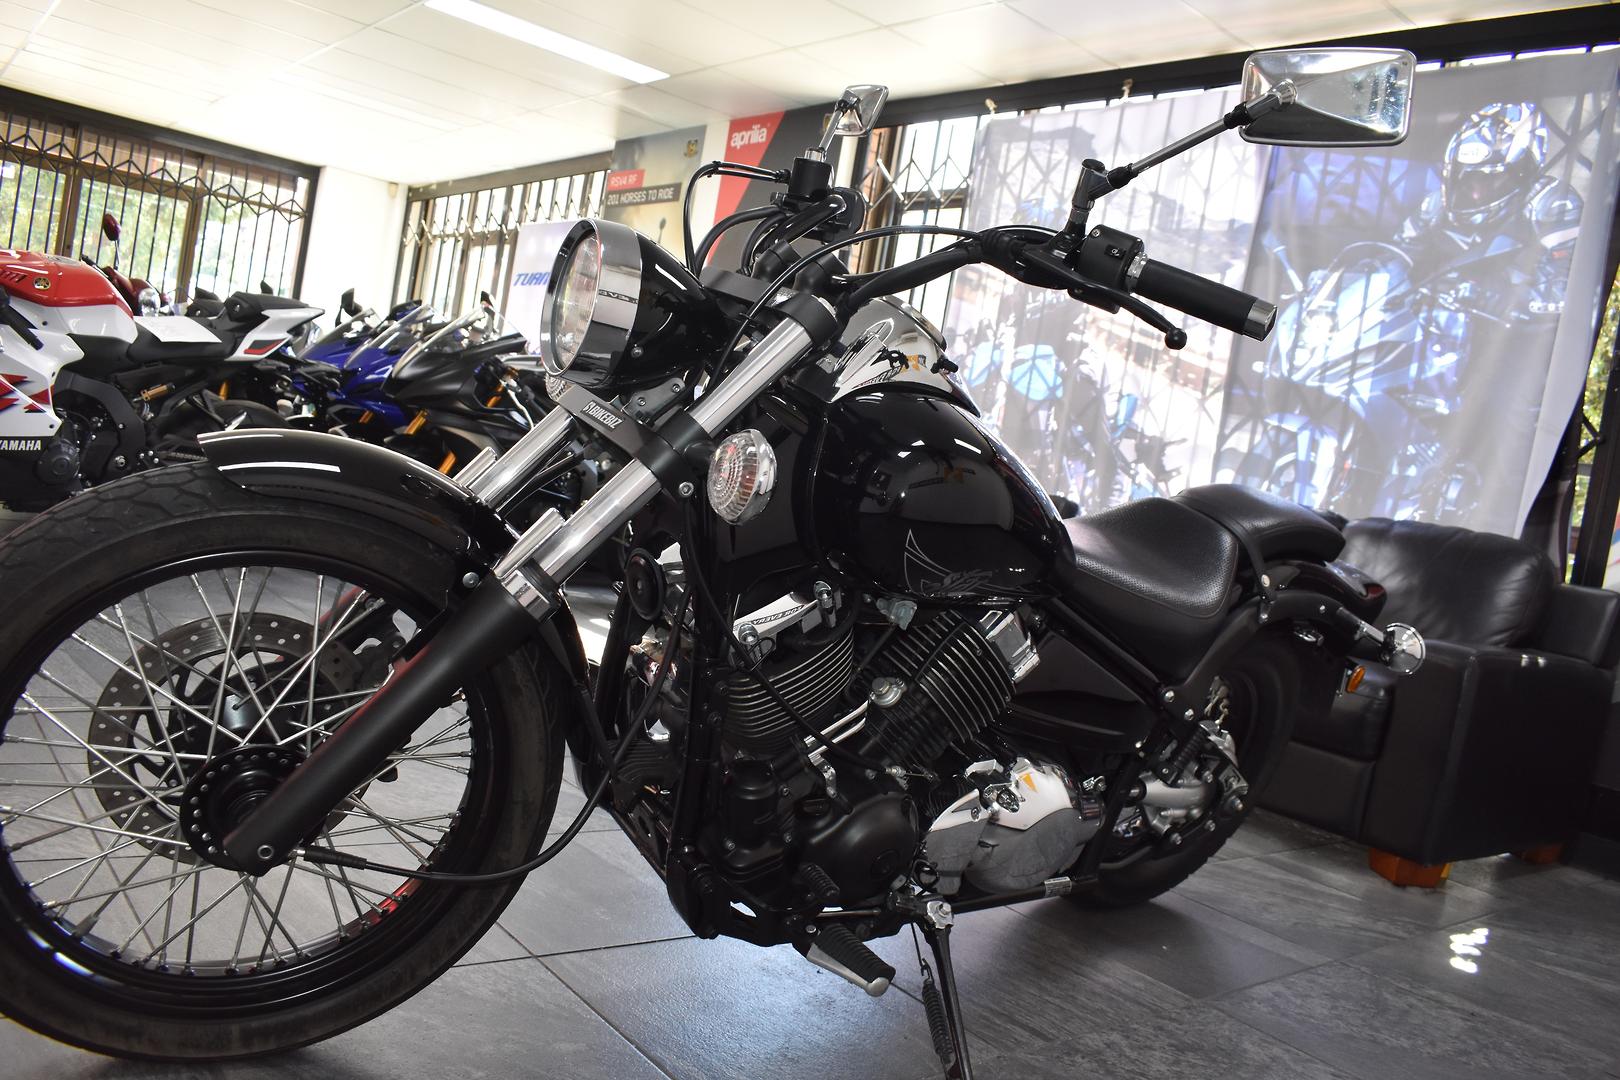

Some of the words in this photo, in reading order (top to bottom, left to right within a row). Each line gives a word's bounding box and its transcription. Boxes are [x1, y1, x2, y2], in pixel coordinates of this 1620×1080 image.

[731, 124, 767, 149] aprilia
[620, 190, 647, 204] HORSES
[648, 189, 657, 201] TO
[658, 187, 674, 200] RIDE
